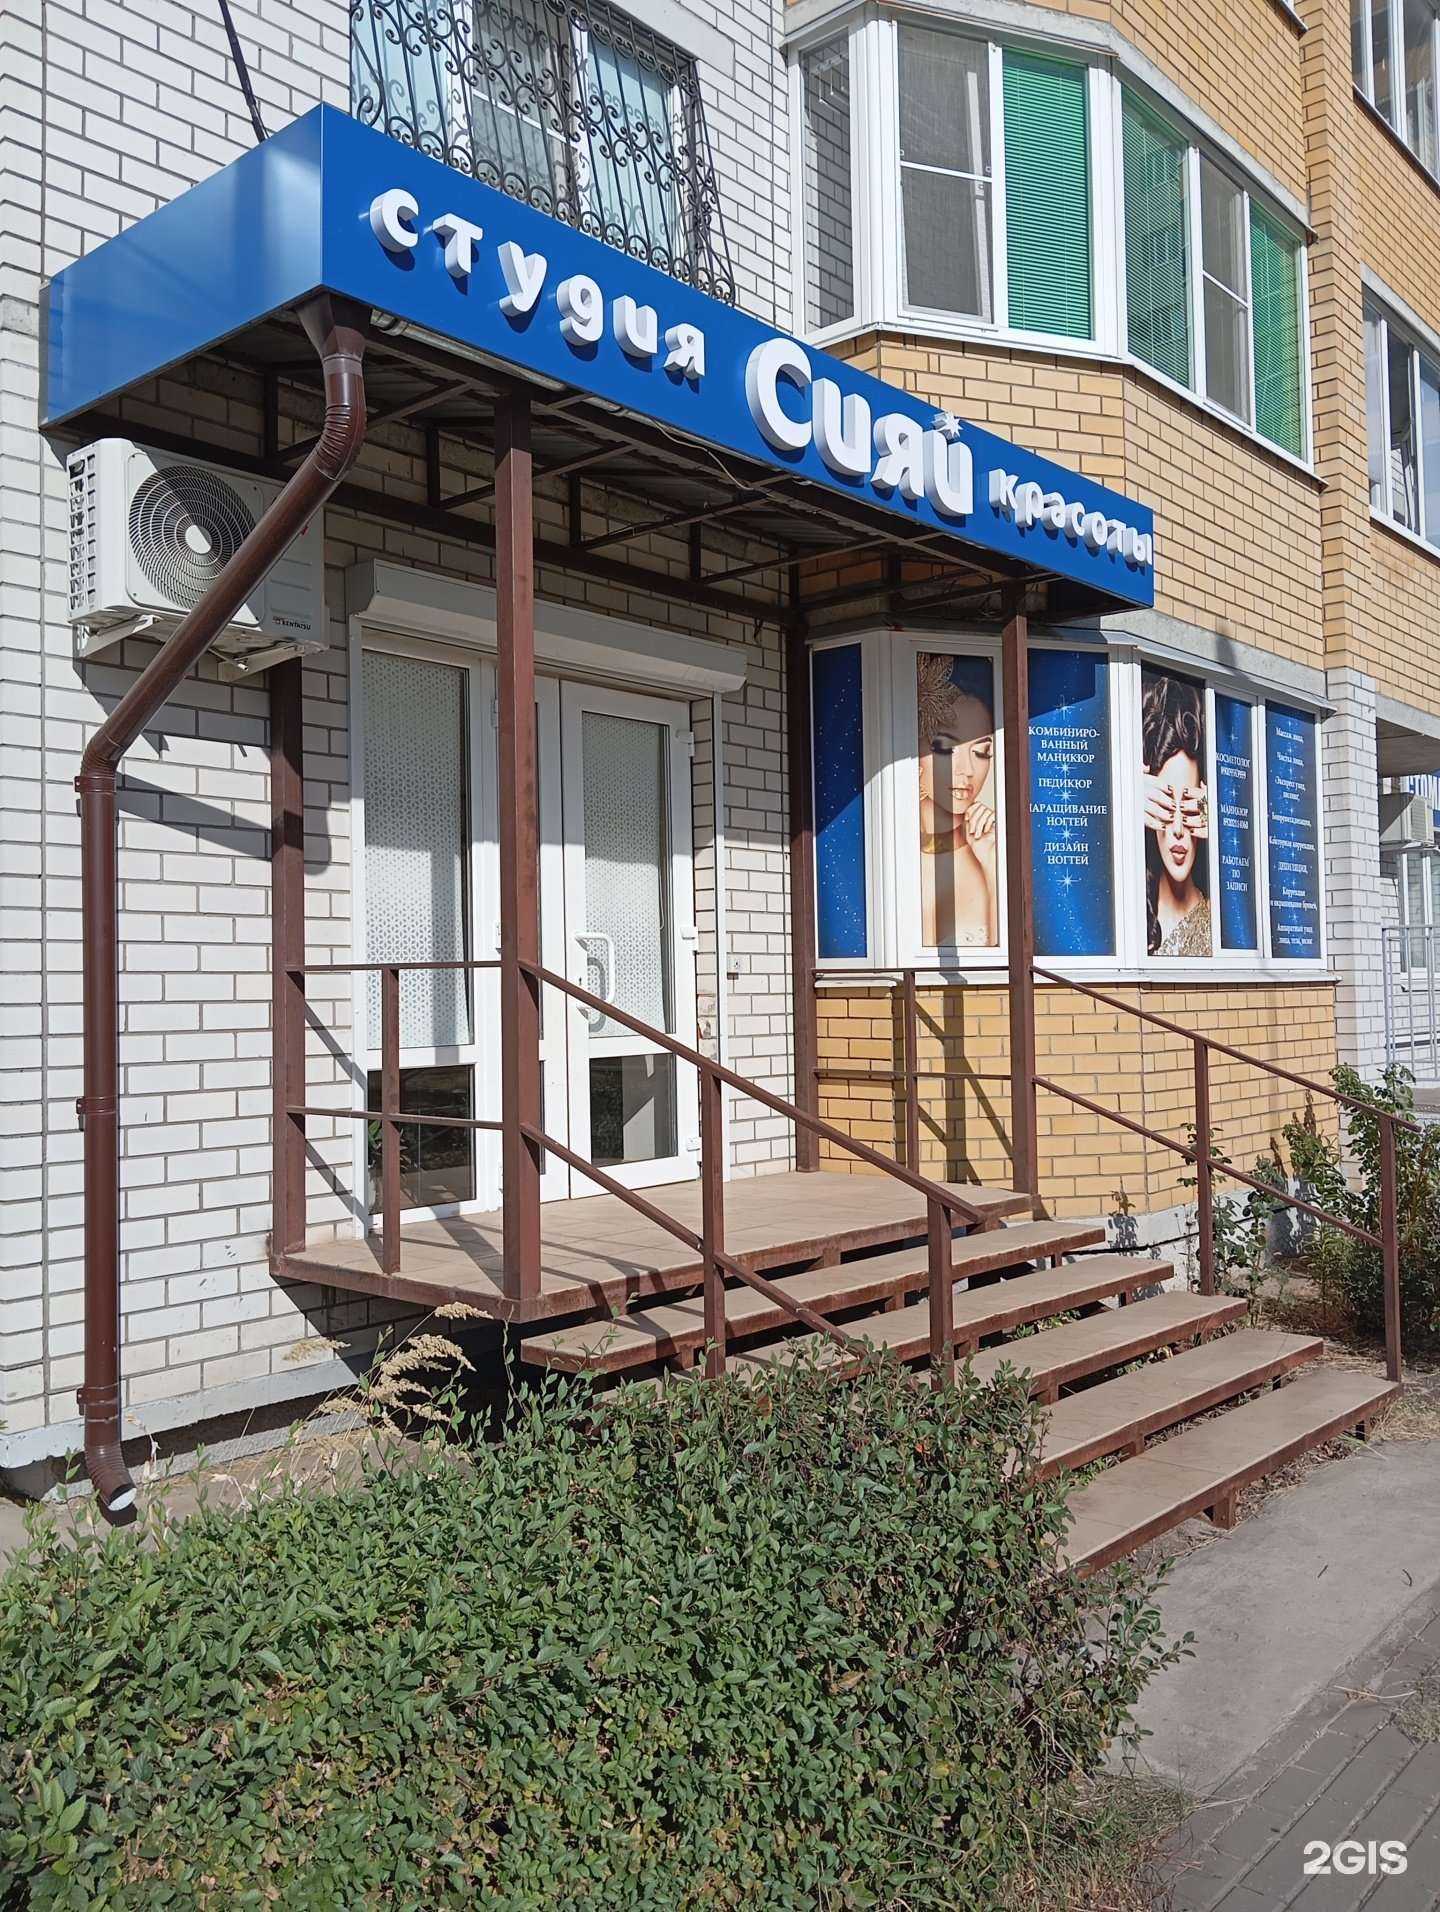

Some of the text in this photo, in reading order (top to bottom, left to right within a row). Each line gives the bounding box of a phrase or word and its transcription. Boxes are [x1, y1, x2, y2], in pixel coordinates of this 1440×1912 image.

[369, 187, 1153, 566] студия Сияй красоты
[1028, 726, 1101, 738] КОМБИНИРО-
[1041, 739, 1089, 751] ВАННЫЙ
[1037, 752, 1095, 764] МАНИКЮР
[1038, 778, 1093, 790] ПЕДИКЮР
[1046, 816, 1089, 828] НОГТЕЙ
[1043, 841, 1089, 853] ДИЗАЙН
[1047, 855, 1089, 866] НОГТЕЙ
[1222, 855, 1250, 867] РАБОТАЕМ
[1231, 869, 1241, 879] ПО
[1226, 881, 1248, 891] ЗАПИСИ
